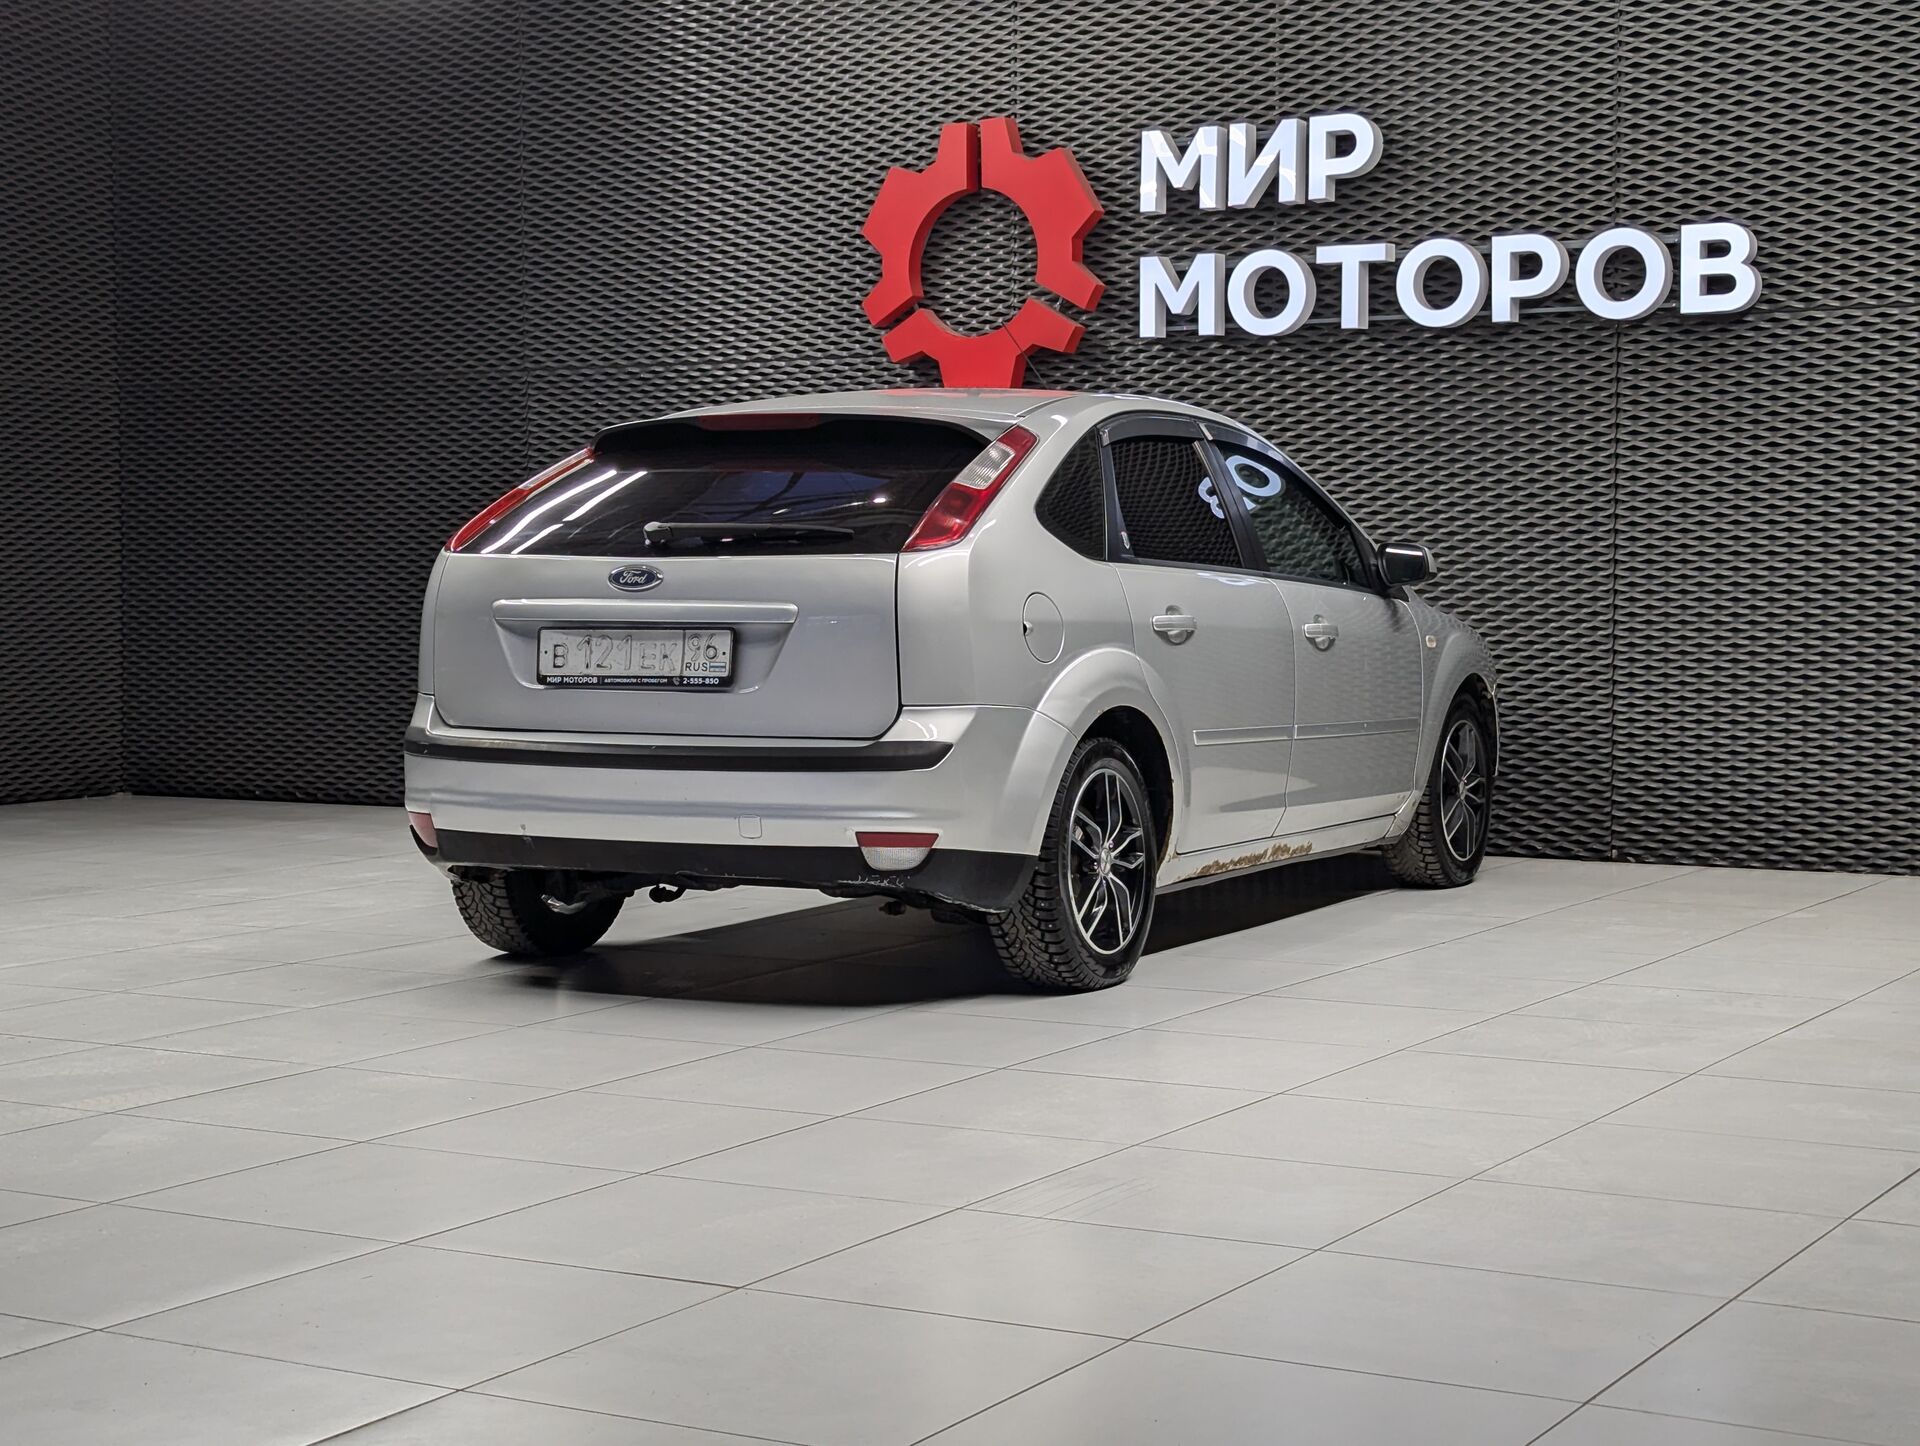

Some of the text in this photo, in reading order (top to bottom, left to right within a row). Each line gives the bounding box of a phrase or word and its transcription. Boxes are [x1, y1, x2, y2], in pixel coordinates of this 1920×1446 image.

[1139, 112, 1384, 214] МИР
[1139, 222, 1762, 339] МОТОРОВ
[619, 570, 648, 584] Ford
[688, 633, 719, 661] 96
[685, 662, 708, 672] RUS
[682, 677, 719, 685] 2-555-850
